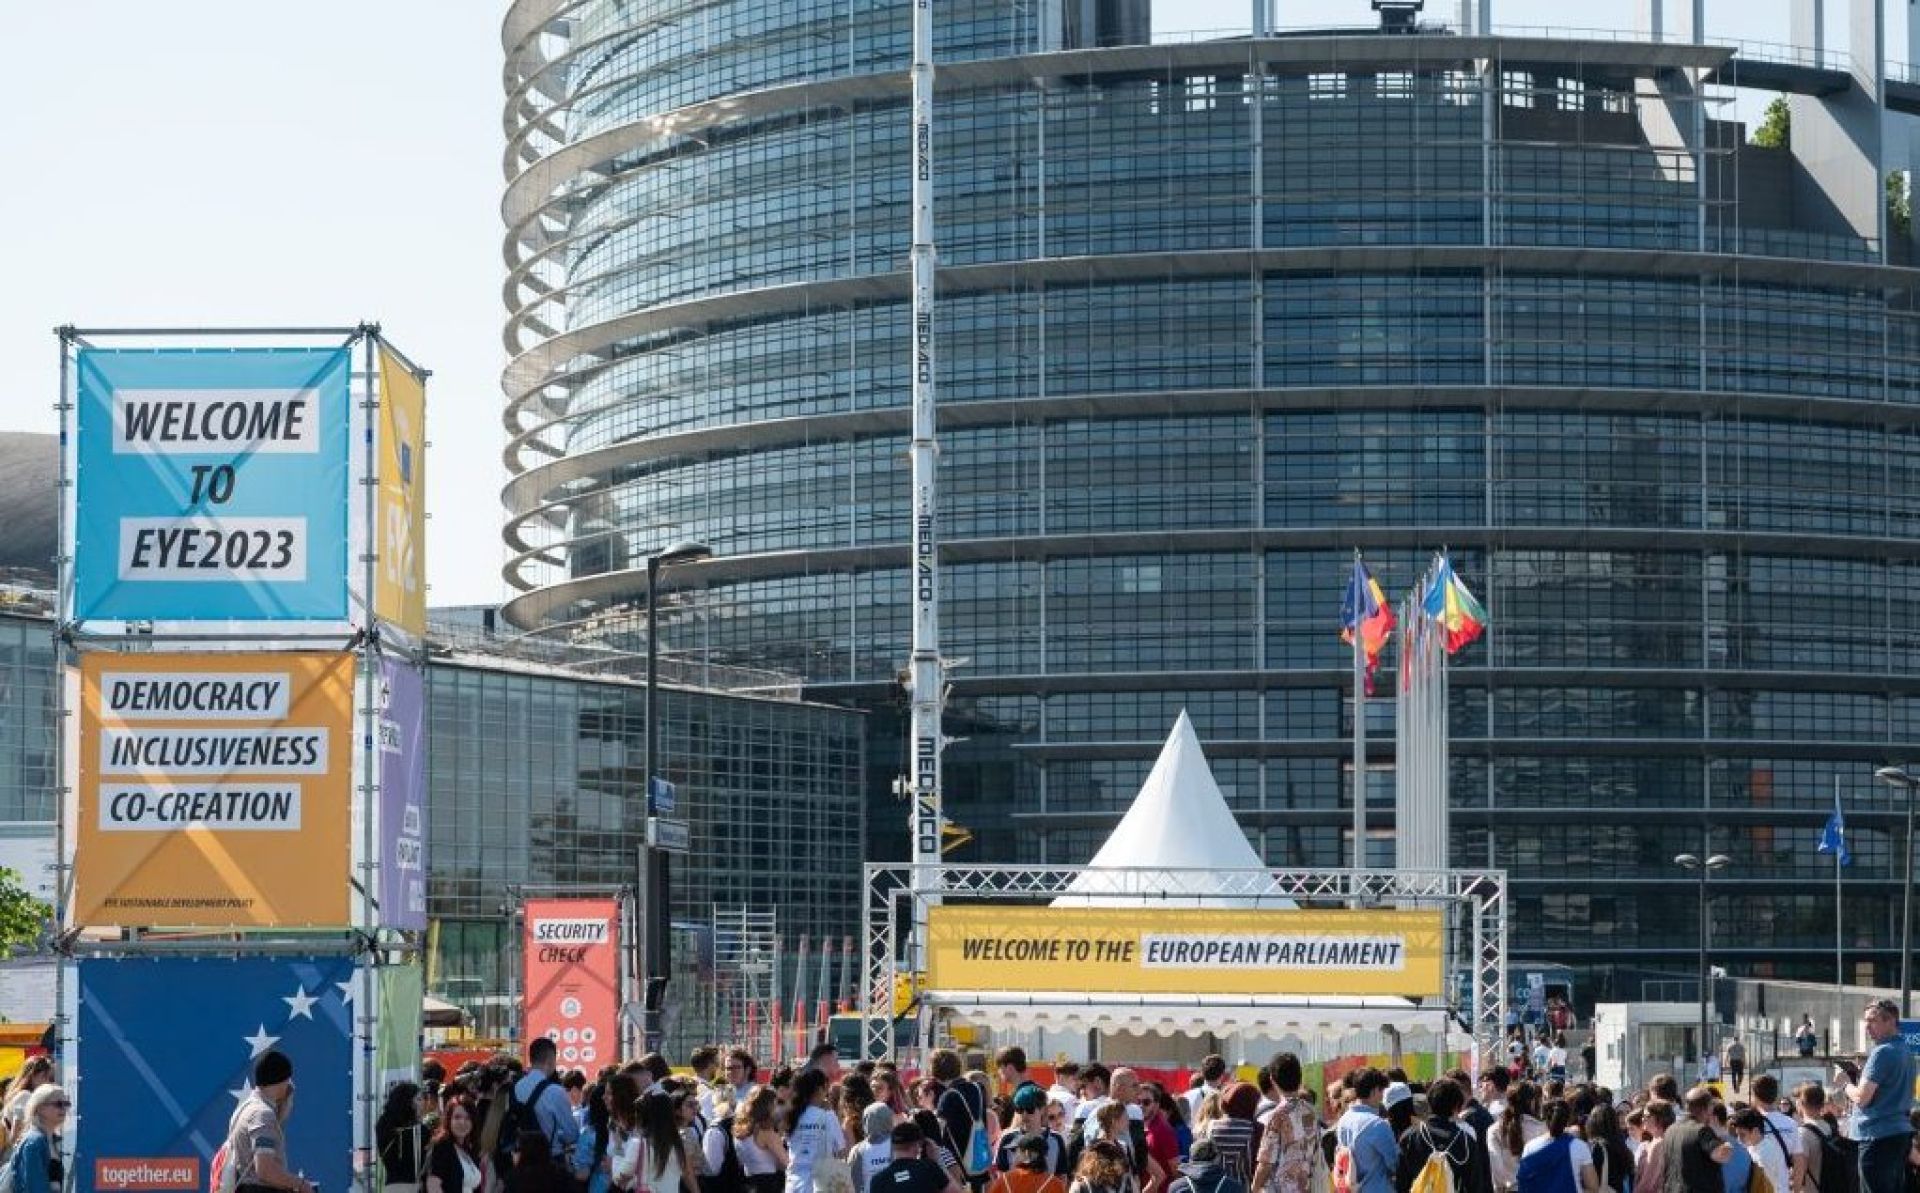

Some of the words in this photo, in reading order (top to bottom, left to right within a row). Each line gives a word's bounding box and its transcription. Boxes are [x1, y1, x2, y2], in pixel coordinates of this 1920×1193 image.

[125, 401, 305, 441] WELCOME
[191, 464, 236, 504] TO
[131, 528, 294, 569] EYE2023
[110, 681, 281, 711] DEMOCRACY
[110, 735, 319, 767] INCLUSIVENESS
[110, 792, 293, 822] CO-CREATION
[918, 737, 936, 854] MEDIACO
[538, 923, 606, 940] SECURITY
[538, 948, 587, 963] CHECK
[963, 938, 1060, 961] WELCOME
[1065, 939, 1091, 962] TO
[1095, 940, 1135, 962] THE
[1147, 941, 1262, 963] EUROPEAN
[1265, 943, 1401, 965] PARLIAMENT
[102, 1163, 193, 1188] together.eu
